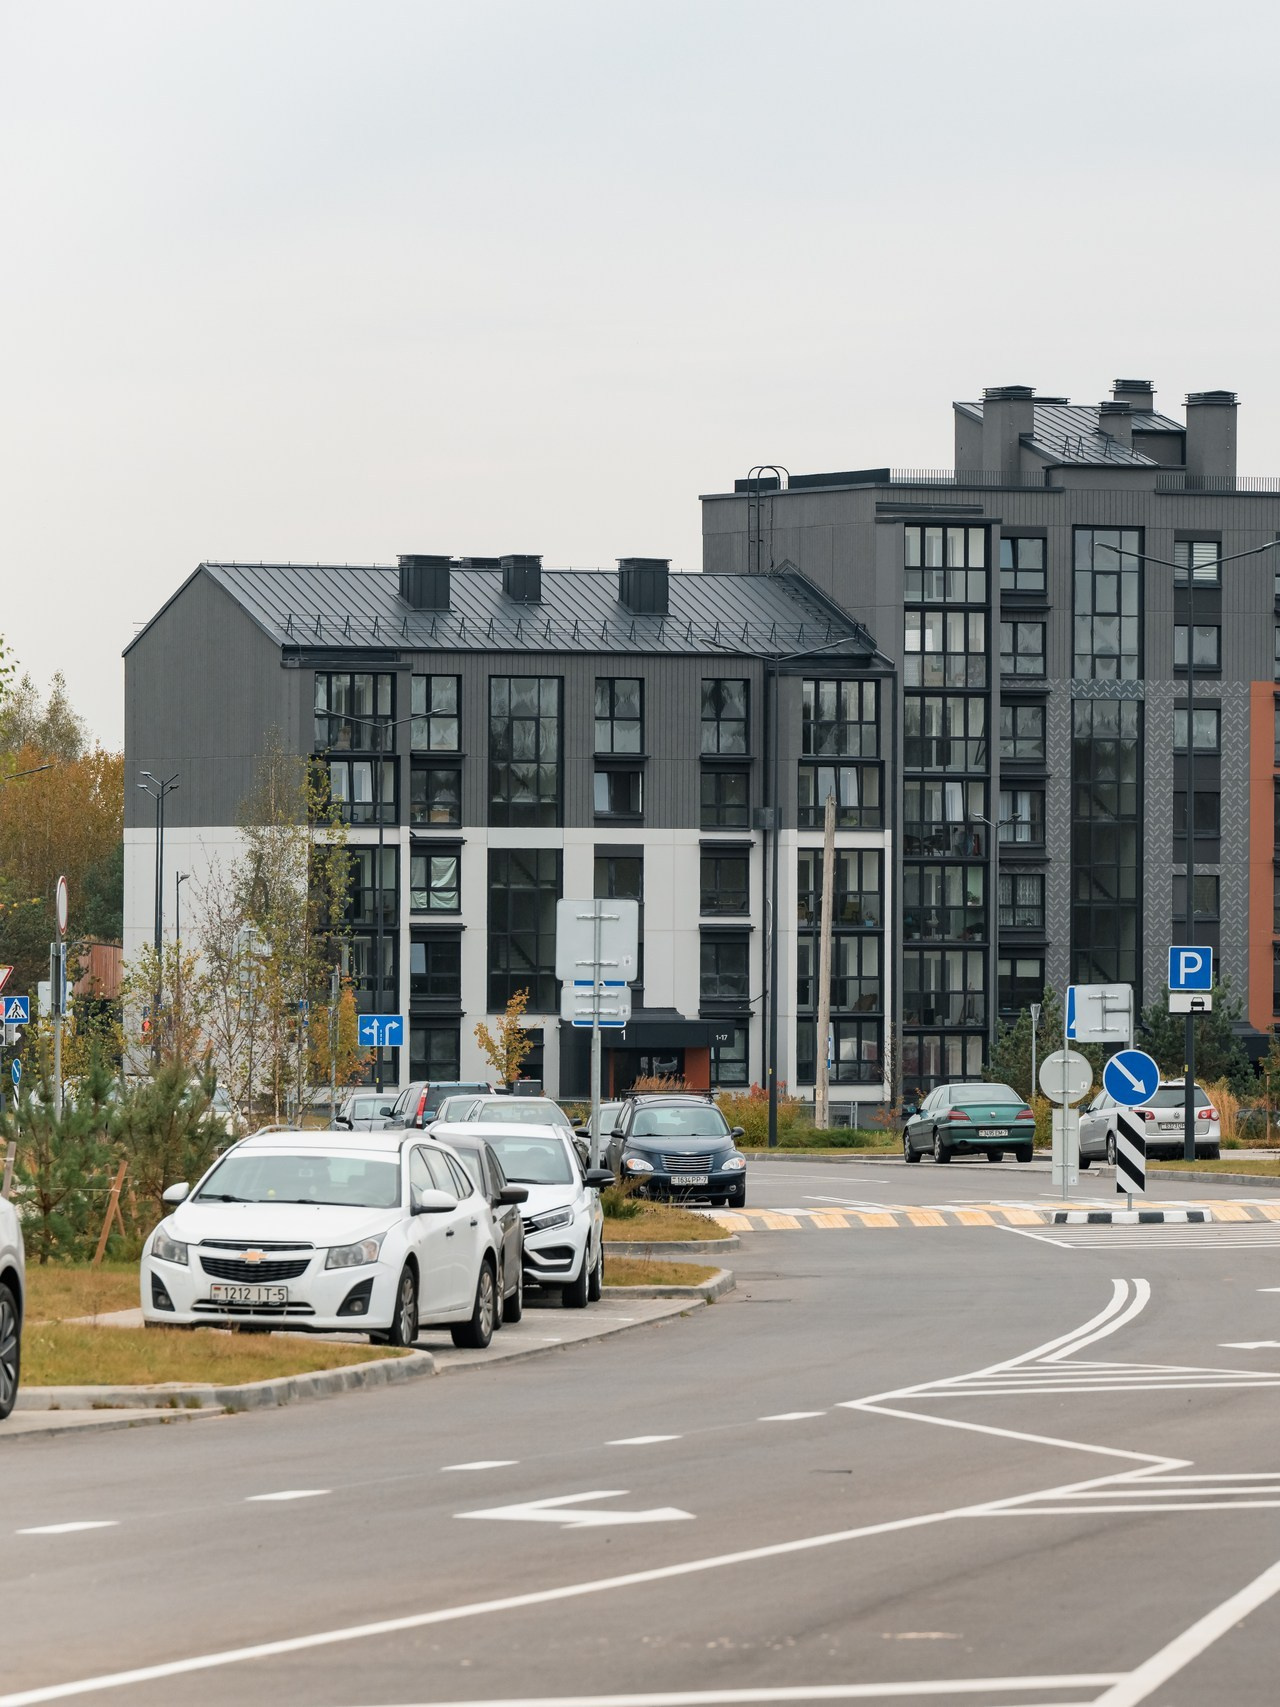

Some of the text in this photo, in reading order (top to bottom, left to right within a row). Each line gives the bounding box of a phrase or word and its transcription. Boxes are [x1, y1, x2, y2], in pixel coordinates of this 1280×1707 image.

[1180, 951, 1203, 985] P
[620, 1029, 626, 1040] 1
[224, 1287, 285, 1301] 1212 IT-5
